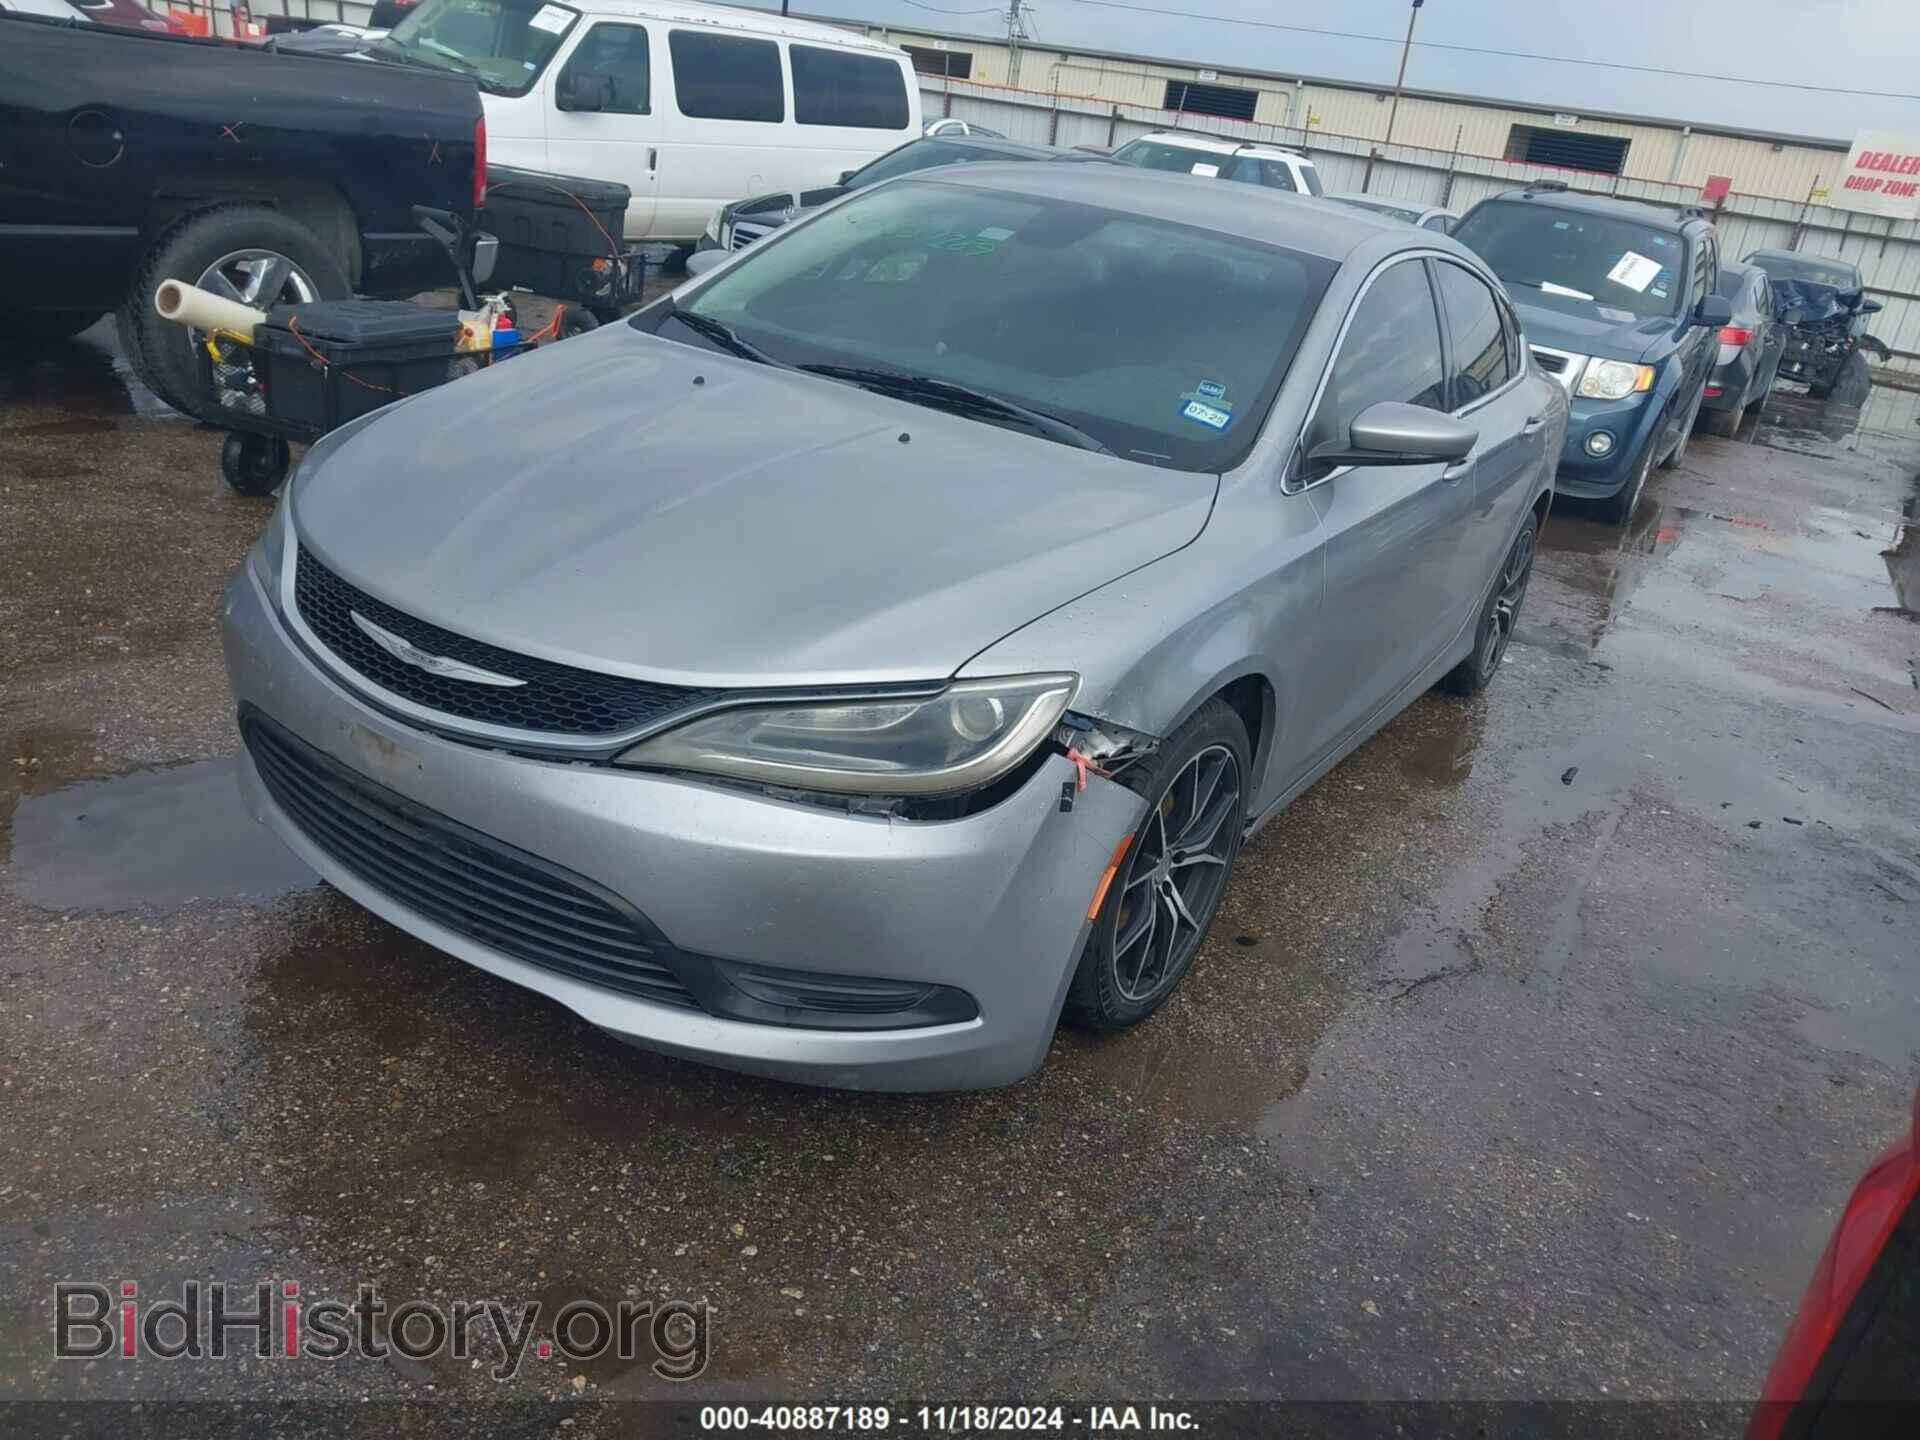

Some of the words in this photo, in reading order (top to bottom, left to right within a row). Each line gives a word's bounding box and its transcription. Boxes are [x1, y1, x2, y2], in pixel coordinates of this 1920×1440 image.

[1855, 150, 1920, 174] DEALER
[1843, 174, 1884, 192] DROP
[1881, 180, 1920, 197] ZONE
